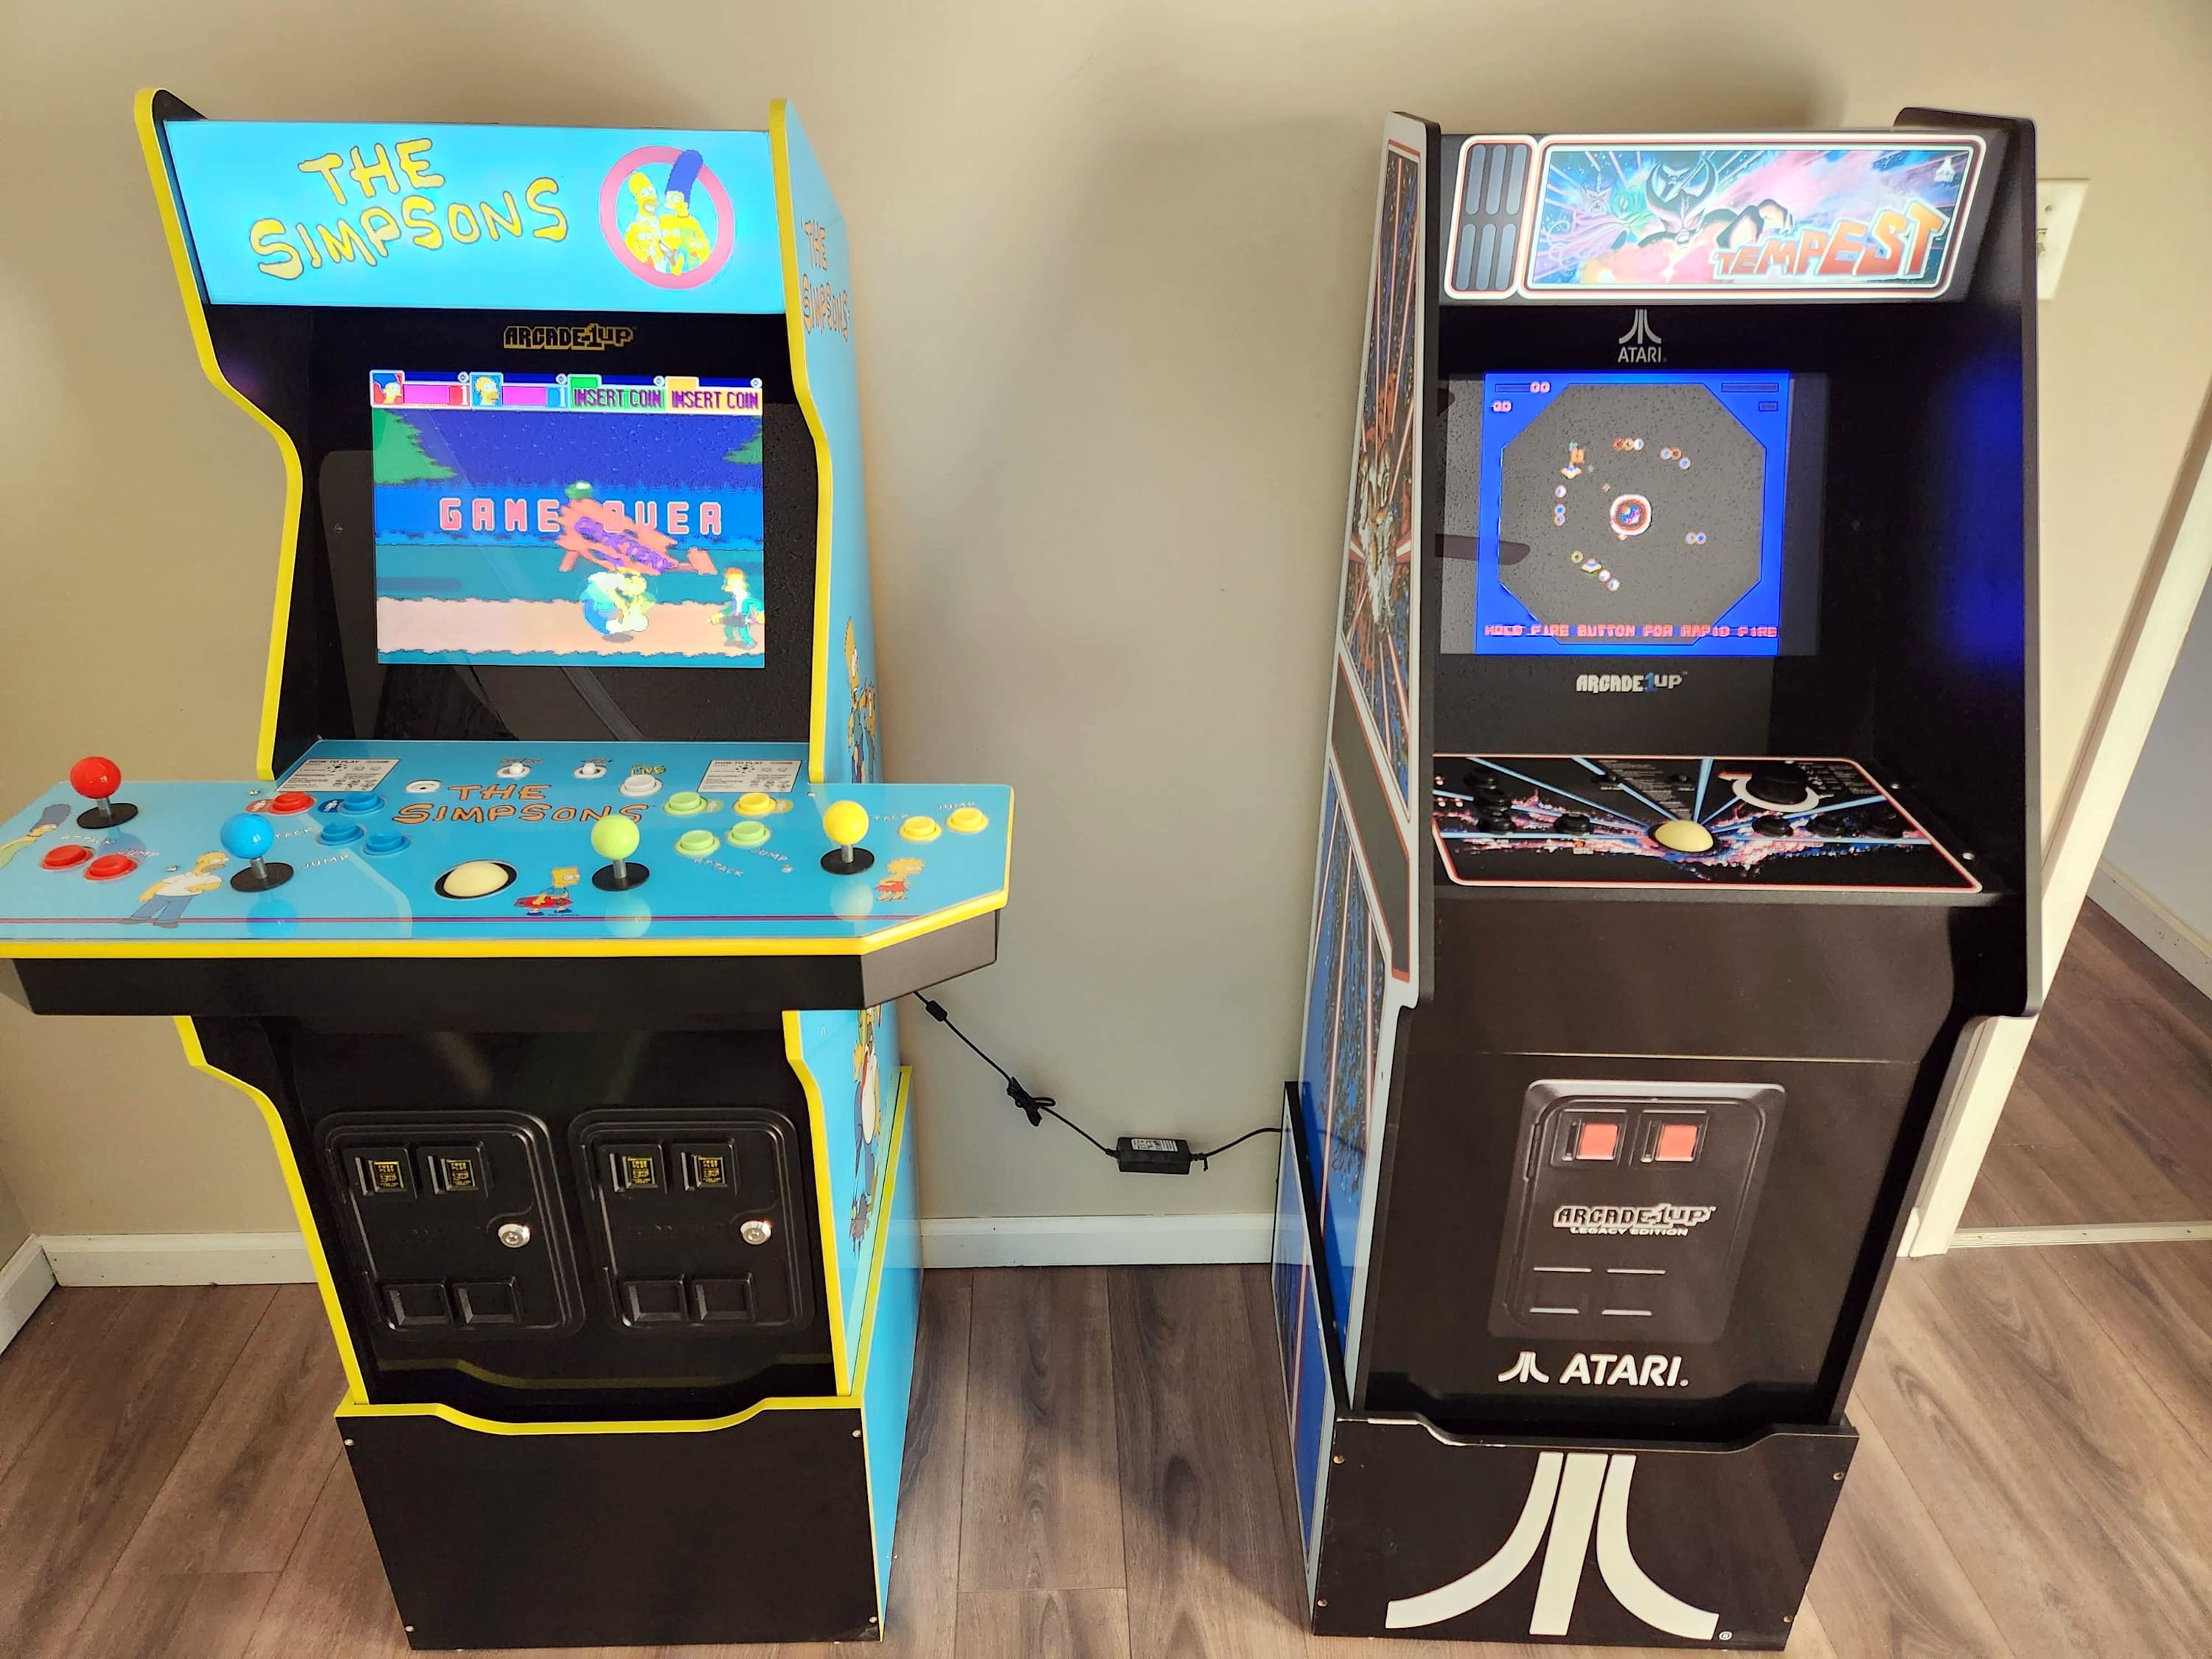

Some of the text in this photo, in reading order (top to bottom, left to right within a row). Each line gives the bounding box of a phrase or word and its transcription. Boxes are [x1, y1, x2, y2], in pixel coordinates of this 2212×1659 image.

[297, 137, 445, 205] THE
[248, 176, 569, 281] SIMPSONS
[1711, 198, 1948, 278] TEMPEST
[801, 218, 827, 271] THE
[802, 273, 850, 343] SIMPSONS
[1618, 347, 1662, 363] ATARI
[574, 388, 662, 408] INSERT COIN
[672, 390, 759, 410] INSERT COIN
[439, 497, 723, 535] GAME OVER
[1531, 624, 1570, 637] FIRE
[1576, 624, 1635, 637] BUTTON
[1642, 625, 1674, 637] FOR
[1737, 626, 1778, 638] FIRE
[448, 783, 552, 801] THE
[392, 802, 650, 824] SIMPSONS
[874, 813, 909, 822] TACK
[275, 826, 313, 840] TACK
[117, 849, 160, 858] JUMP
[301, 852, 349, 869] JUMP
[748, 847, 789, 861] JUMP
[1571, 1227, 1689, 1237] LEGACY EDITION
[1558, 1352, 1683, 1388] ATARI
